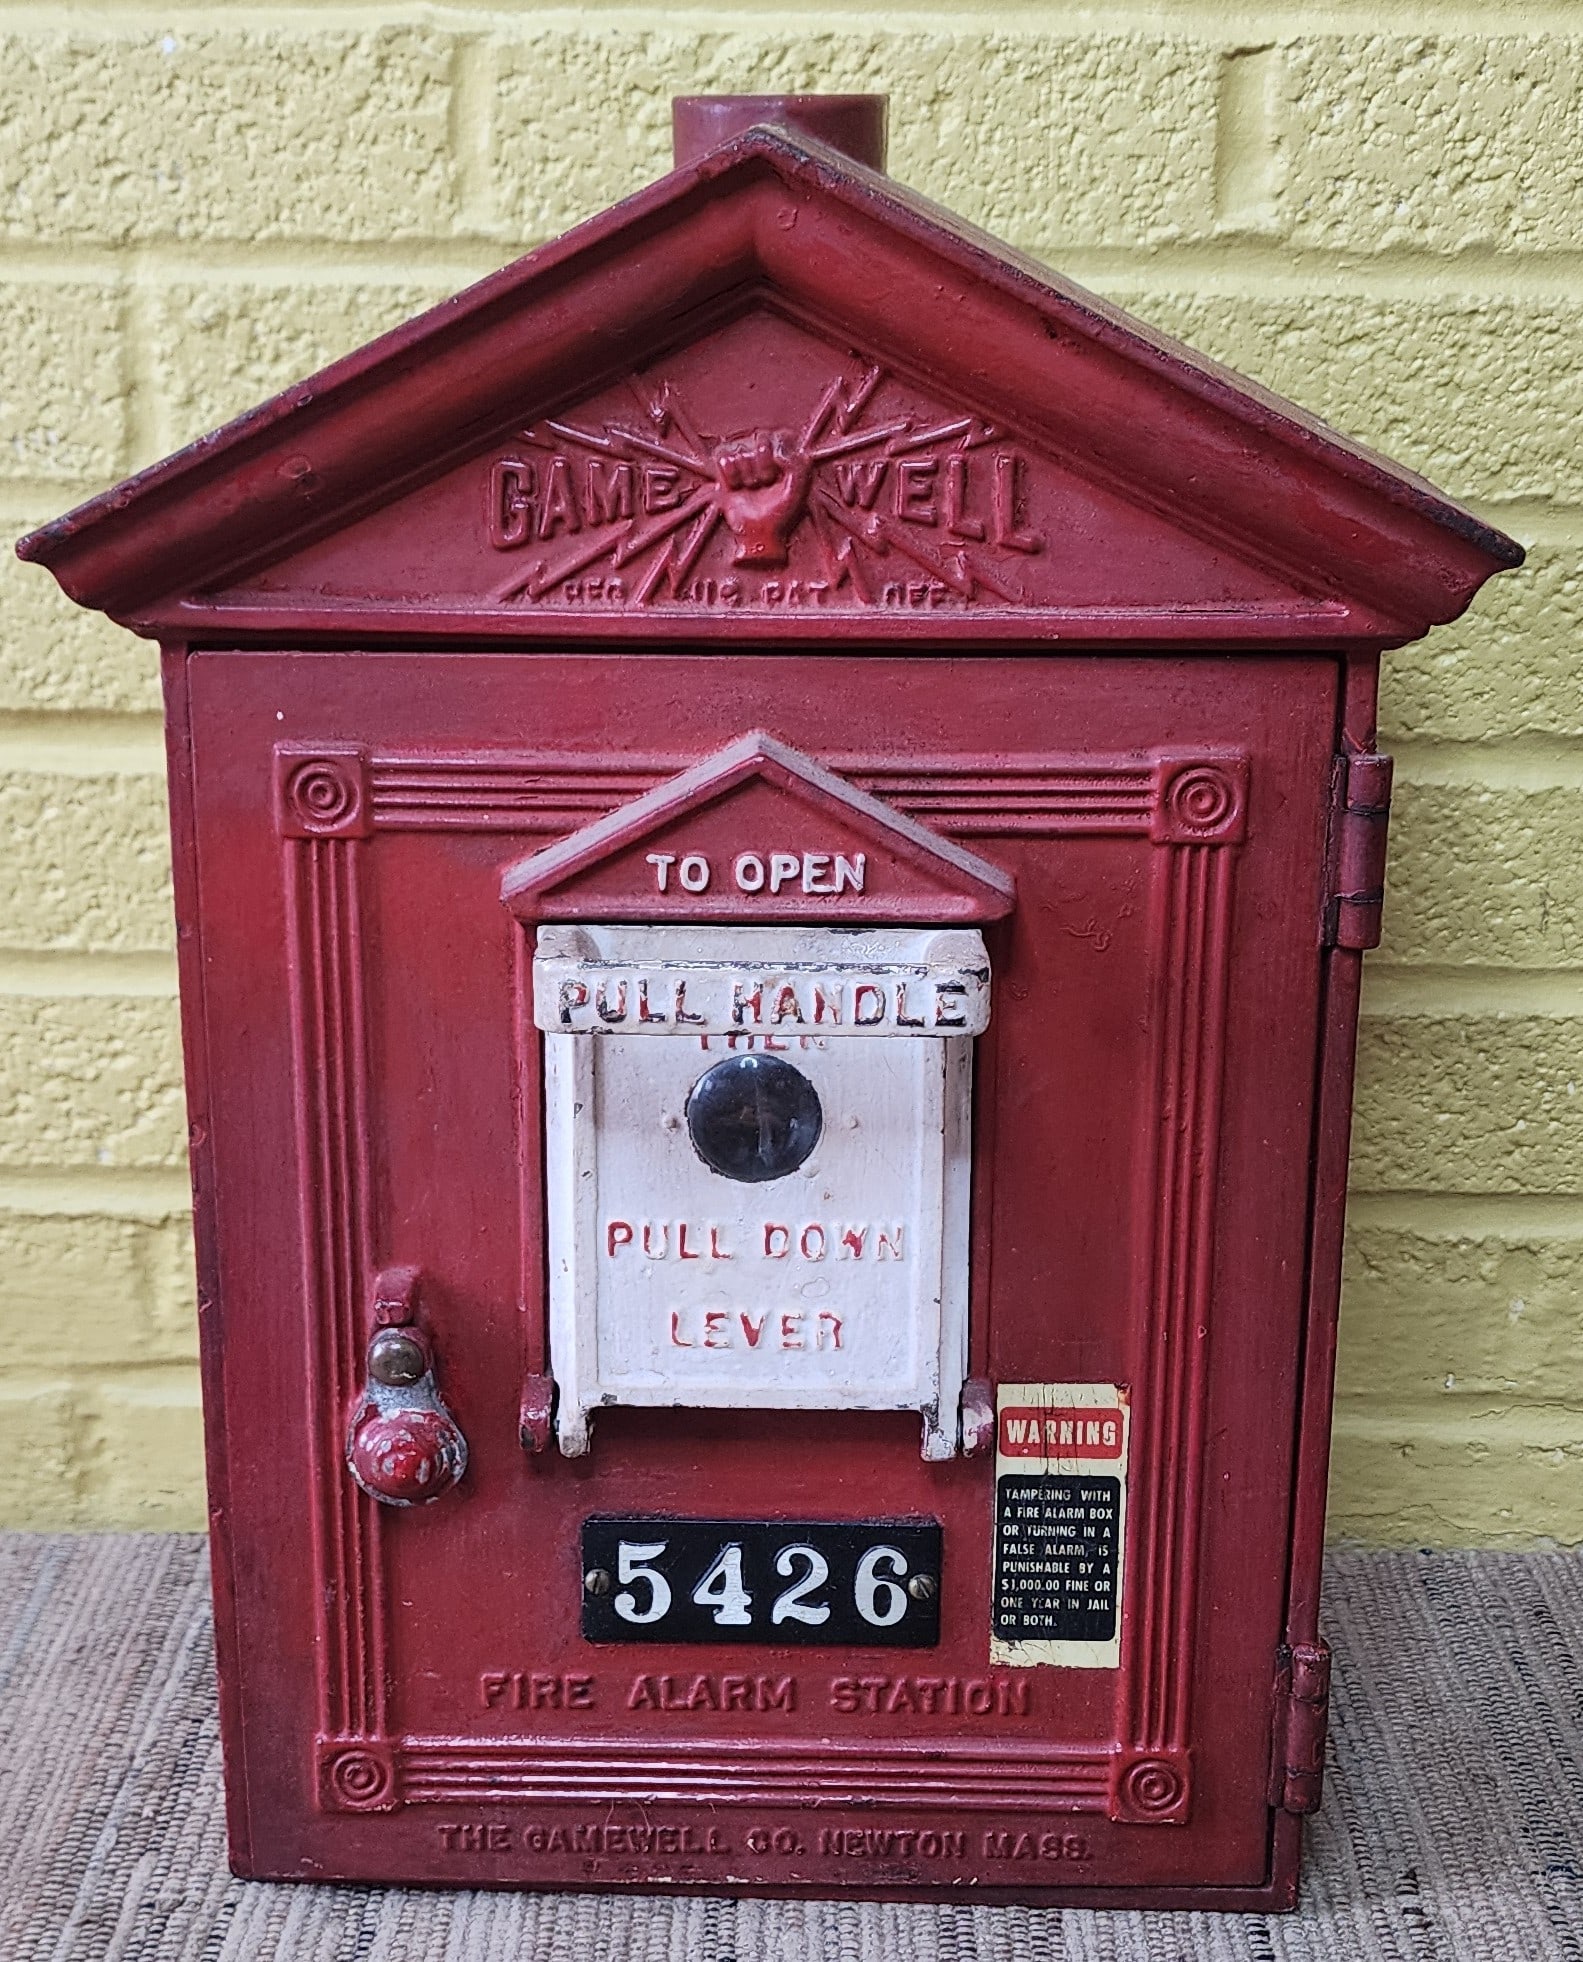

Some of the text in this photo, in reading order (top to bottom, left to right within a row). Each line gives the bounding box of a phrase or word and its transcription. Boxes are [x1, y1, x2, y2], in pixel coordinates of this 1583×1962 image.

[646, 853, 866, 894] TO OPEN
[558, 978, 967, 1027] PULL HANDLE
[606, 1220, 904, 1262] PULL DOWN
[670, 1311, 844, 1350] LEVER
[1006, 1419, 1117, 1446] WARNING
[1005, 1488, 1111, 1502] TAMPERING WITH
[1003, 1506, 1113, 1520] A FIRE ALARM BOX
[1002, 1524, 1111, 1538] OR TURNING IN A
[1003, 1543, 1036, 1555] FALSE
[1098, 1545, 1109, 1556] IS
[1002, 1561, 1111, 1574] PUNISHABLE BY A
[613, 1540, 909, 1627] 5426
[1065, 1580, 1089, 1592] FINE
[1094, 1580, 1111, 1592] OR
[1000, 1596, 1110, 1610] ONE YEAR IN JAIL
[1000, 1614, 1058, 1627] OR BOTH.
[480, 1672, 1031, 1716] FIRE ALARM STATION
[437, 1823, 512, 1852] THE
[522, 1824, 726, 1855] GAMEWELL
[746, 1827, 803, 1855] CO.
[818, 1828, 965, 1858] NEWTON
